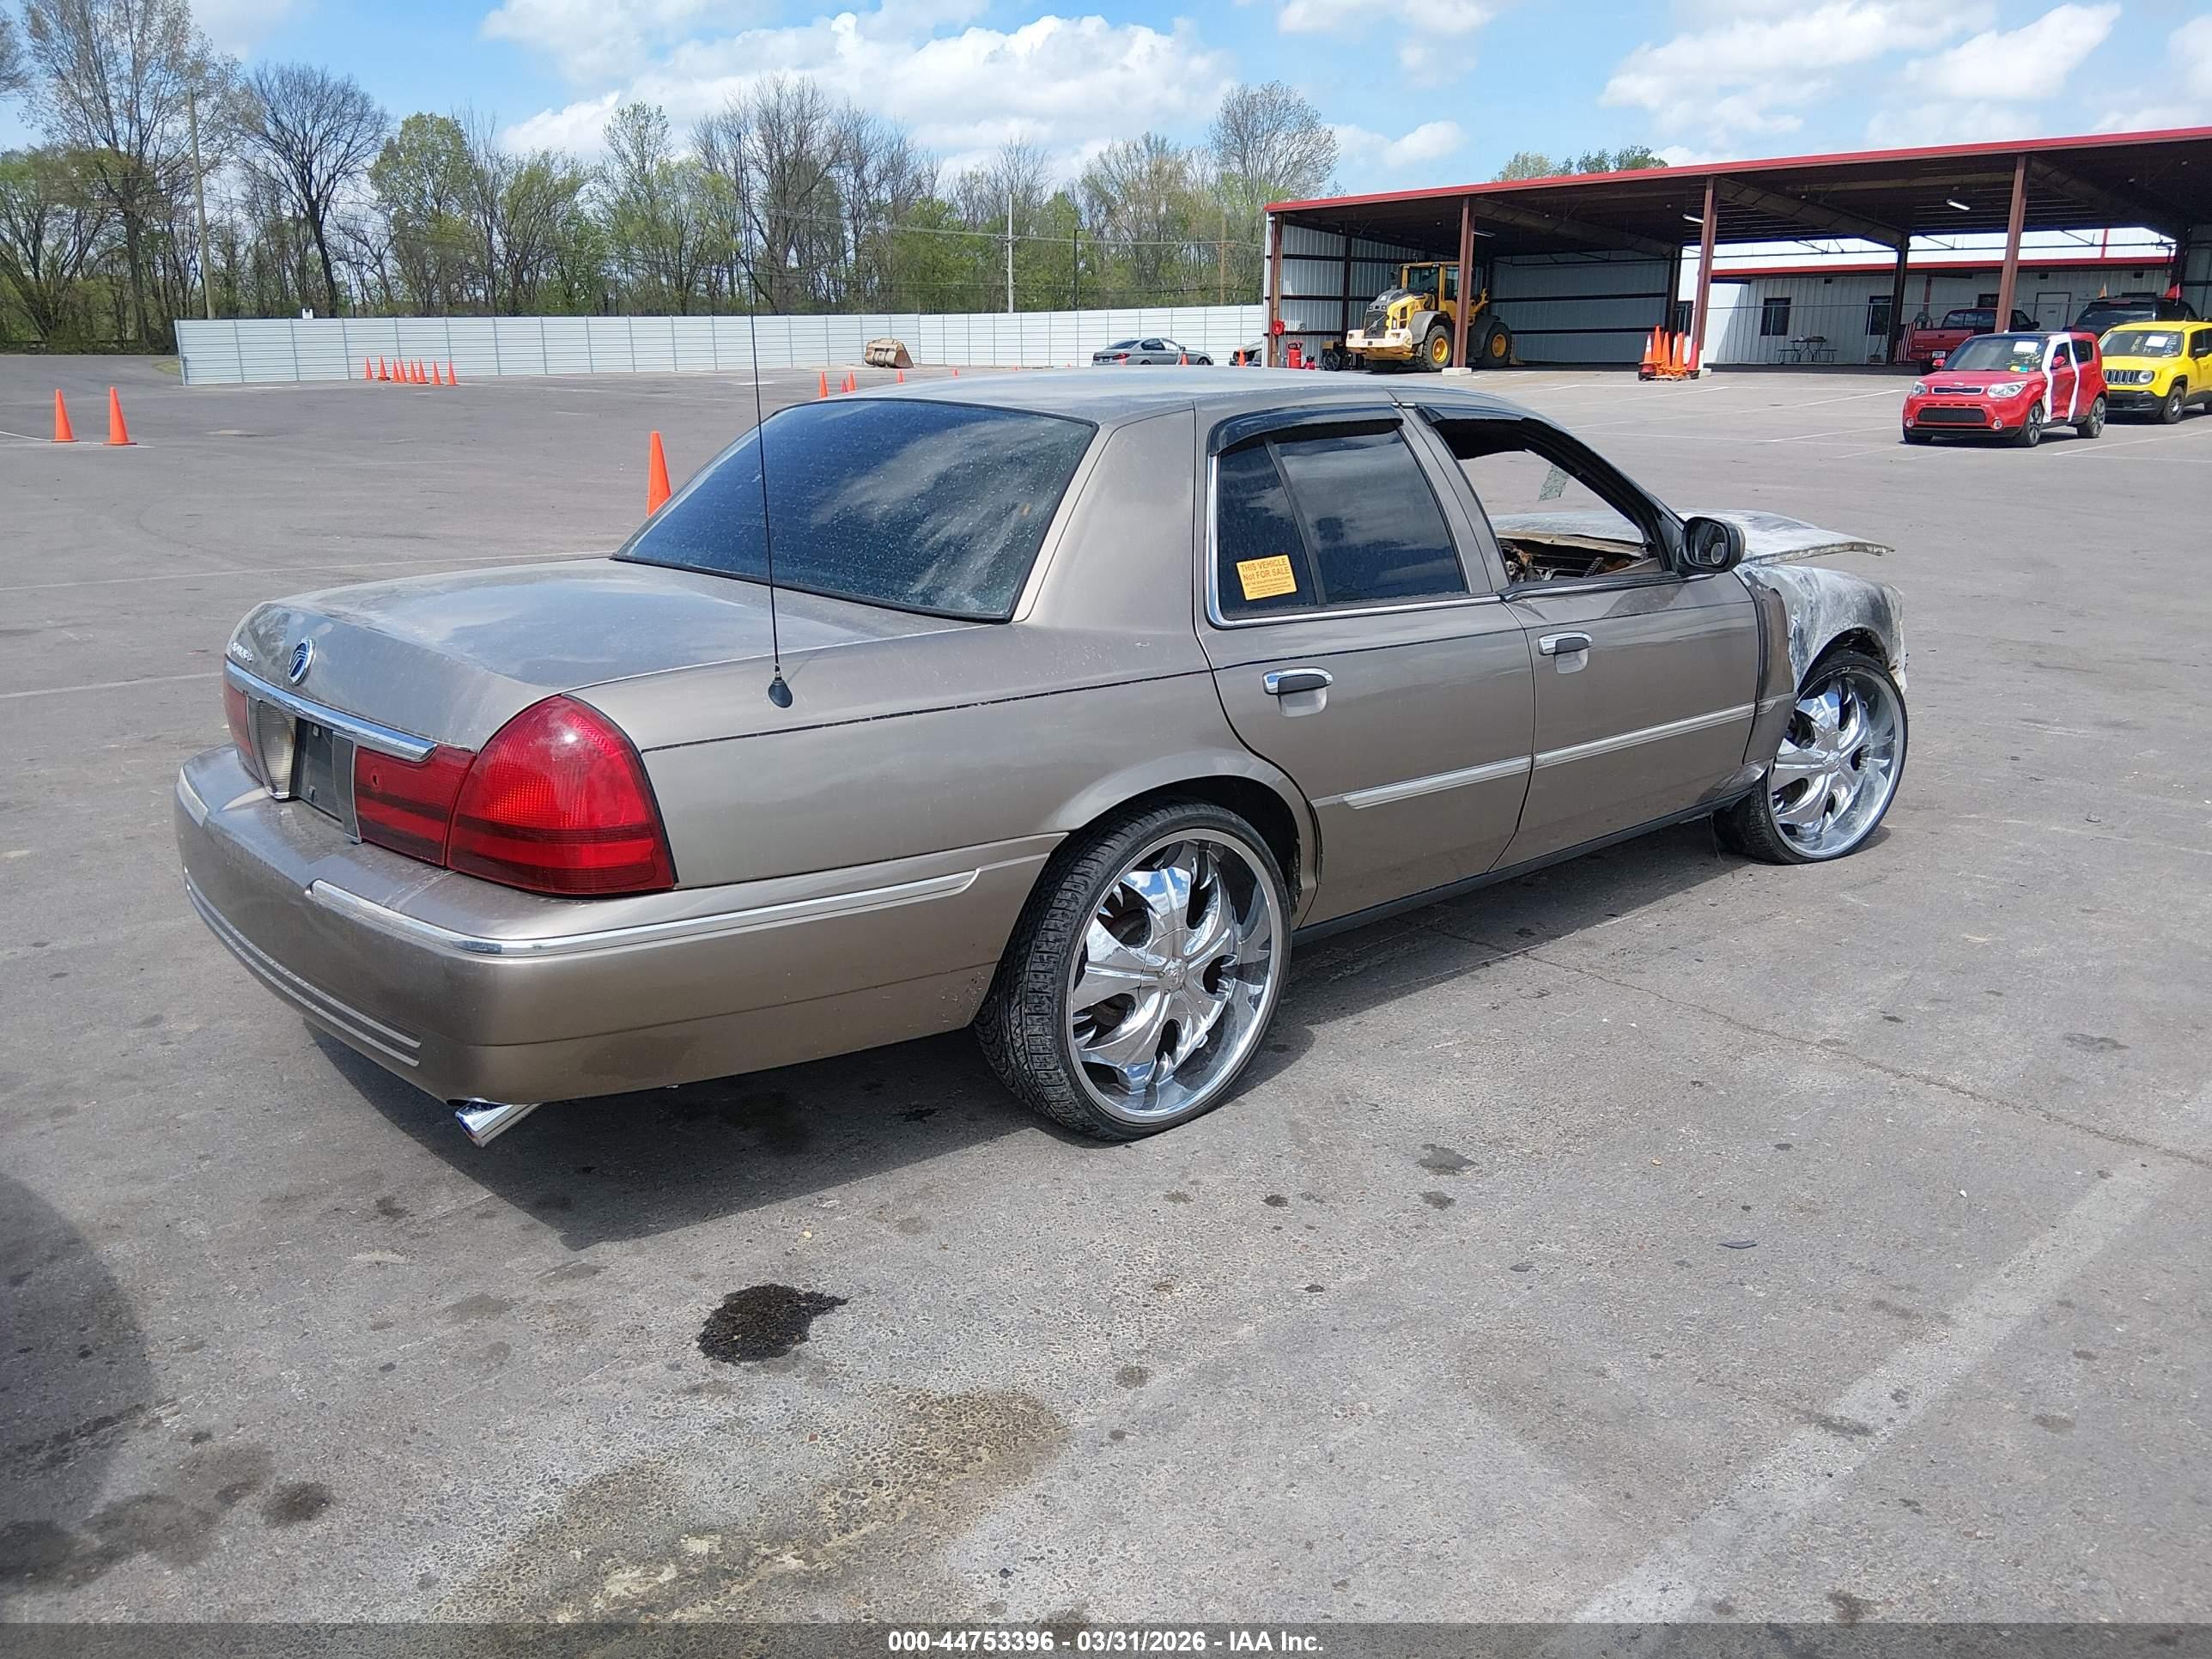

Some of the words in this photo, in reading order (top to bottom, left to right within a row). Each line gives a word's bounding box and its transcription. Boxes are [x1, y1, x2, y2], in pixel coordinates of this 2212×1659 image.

[1240, 563, 1256, 572] THIS
[1257, 558, 1287, 569] VEHICLE
[1256, 570, 1271, 579] FOR
[1272, 567, 1290, 576] SALE
